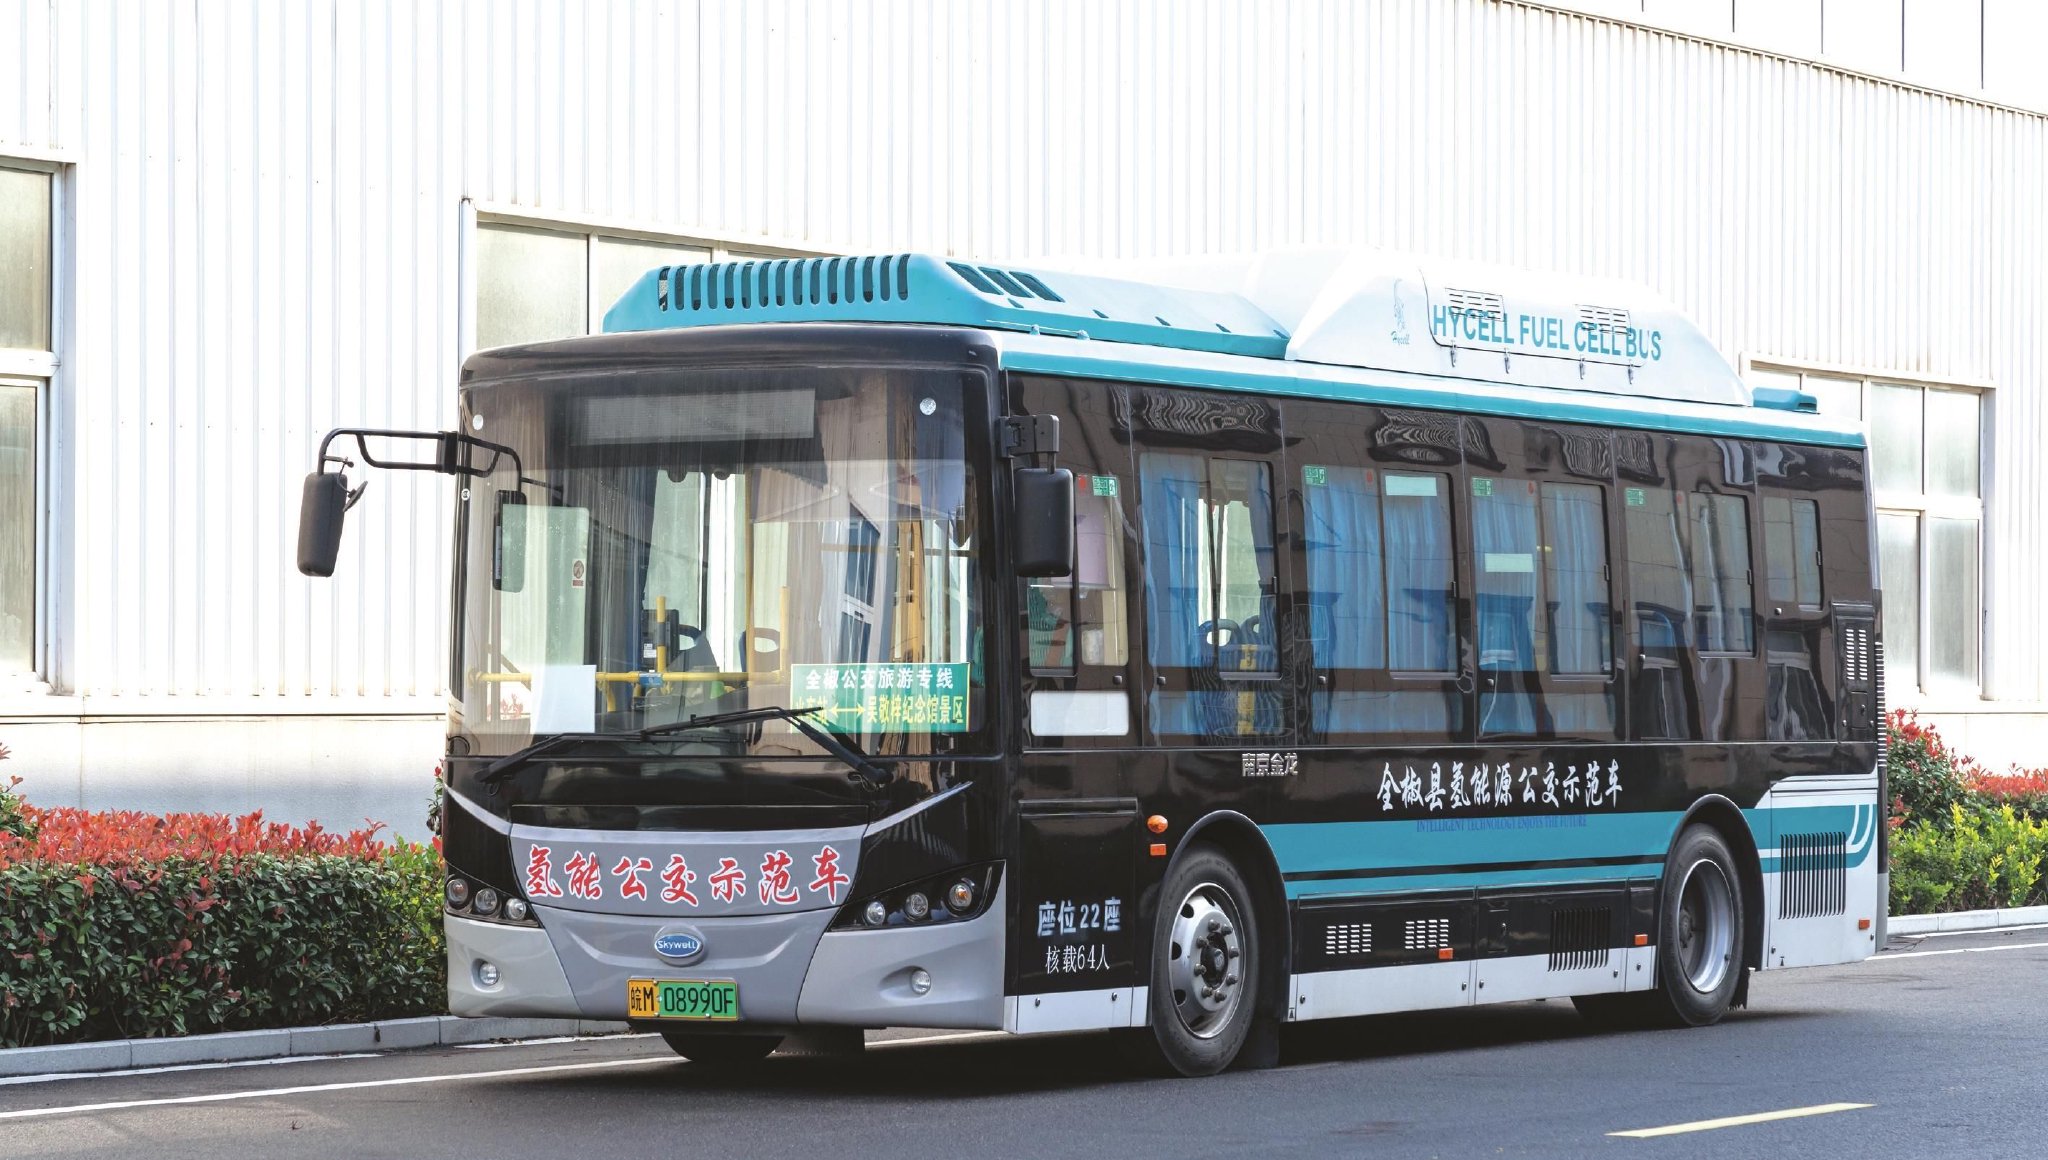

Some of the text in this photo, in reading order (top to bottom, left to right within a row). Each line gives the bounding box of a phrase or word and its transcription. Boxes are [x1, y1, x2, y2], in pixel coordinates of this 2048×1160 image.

[1433, 304, 1662, 361] HYCELL FUEL CELL BUS
[805, 667, 954, 690] 全椒公交旅游专线
[866, 694, 964, 725] 吴敬梓纪念馆景区
[1241, 752, 1299, 777] 南京金龙
[1416, 819, 1465, 833] INTELLIGENT
[1467, 817, 1517, 831] TECHNOLOGY
[1545, 815, 1559, 828] THE
[1560, 814, 1588, 828] FUTURE
[525, 843, 851, 907] 氢能公交示范车
[1037, 896, 1121, 937] 座位22座
[657, 940, 697, 950] Skywell
[1045, 944, 1110, 974] 核载64人
